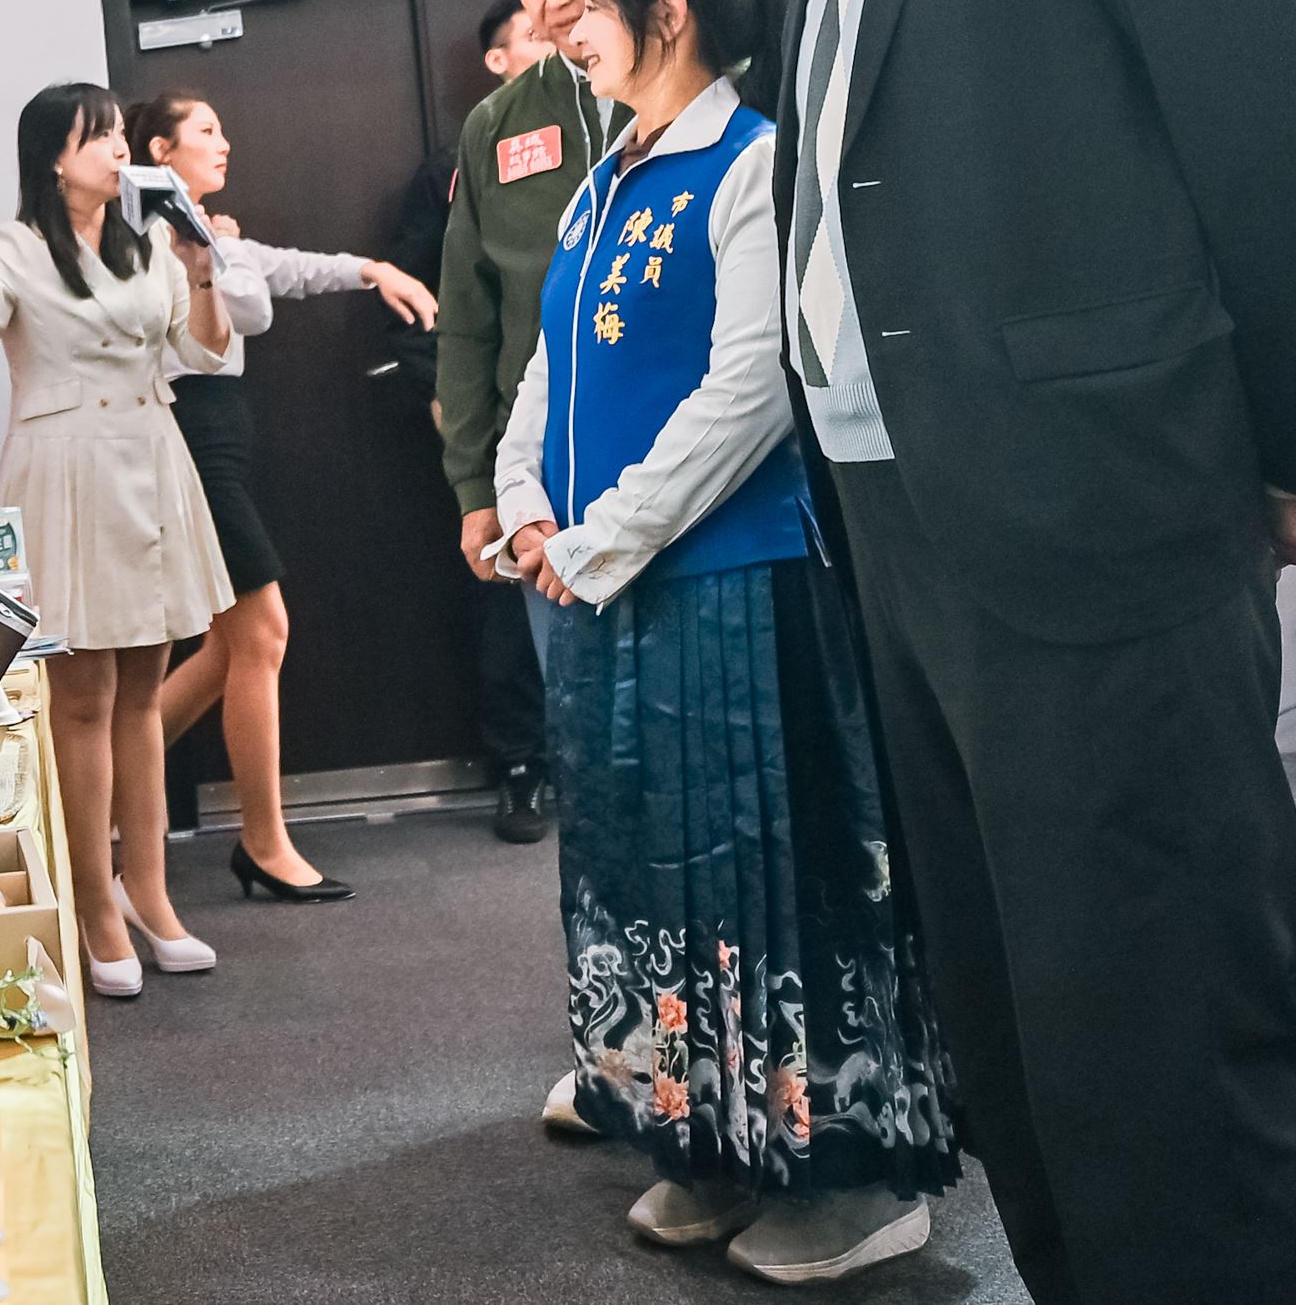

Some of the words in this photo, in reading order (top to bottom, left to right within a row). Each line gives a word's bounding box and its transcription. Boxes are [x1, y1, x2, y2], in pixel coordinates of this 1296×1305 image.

[593, 206, 655, 345] 陳美梅
[639, 190, 695, 289] 市議員
